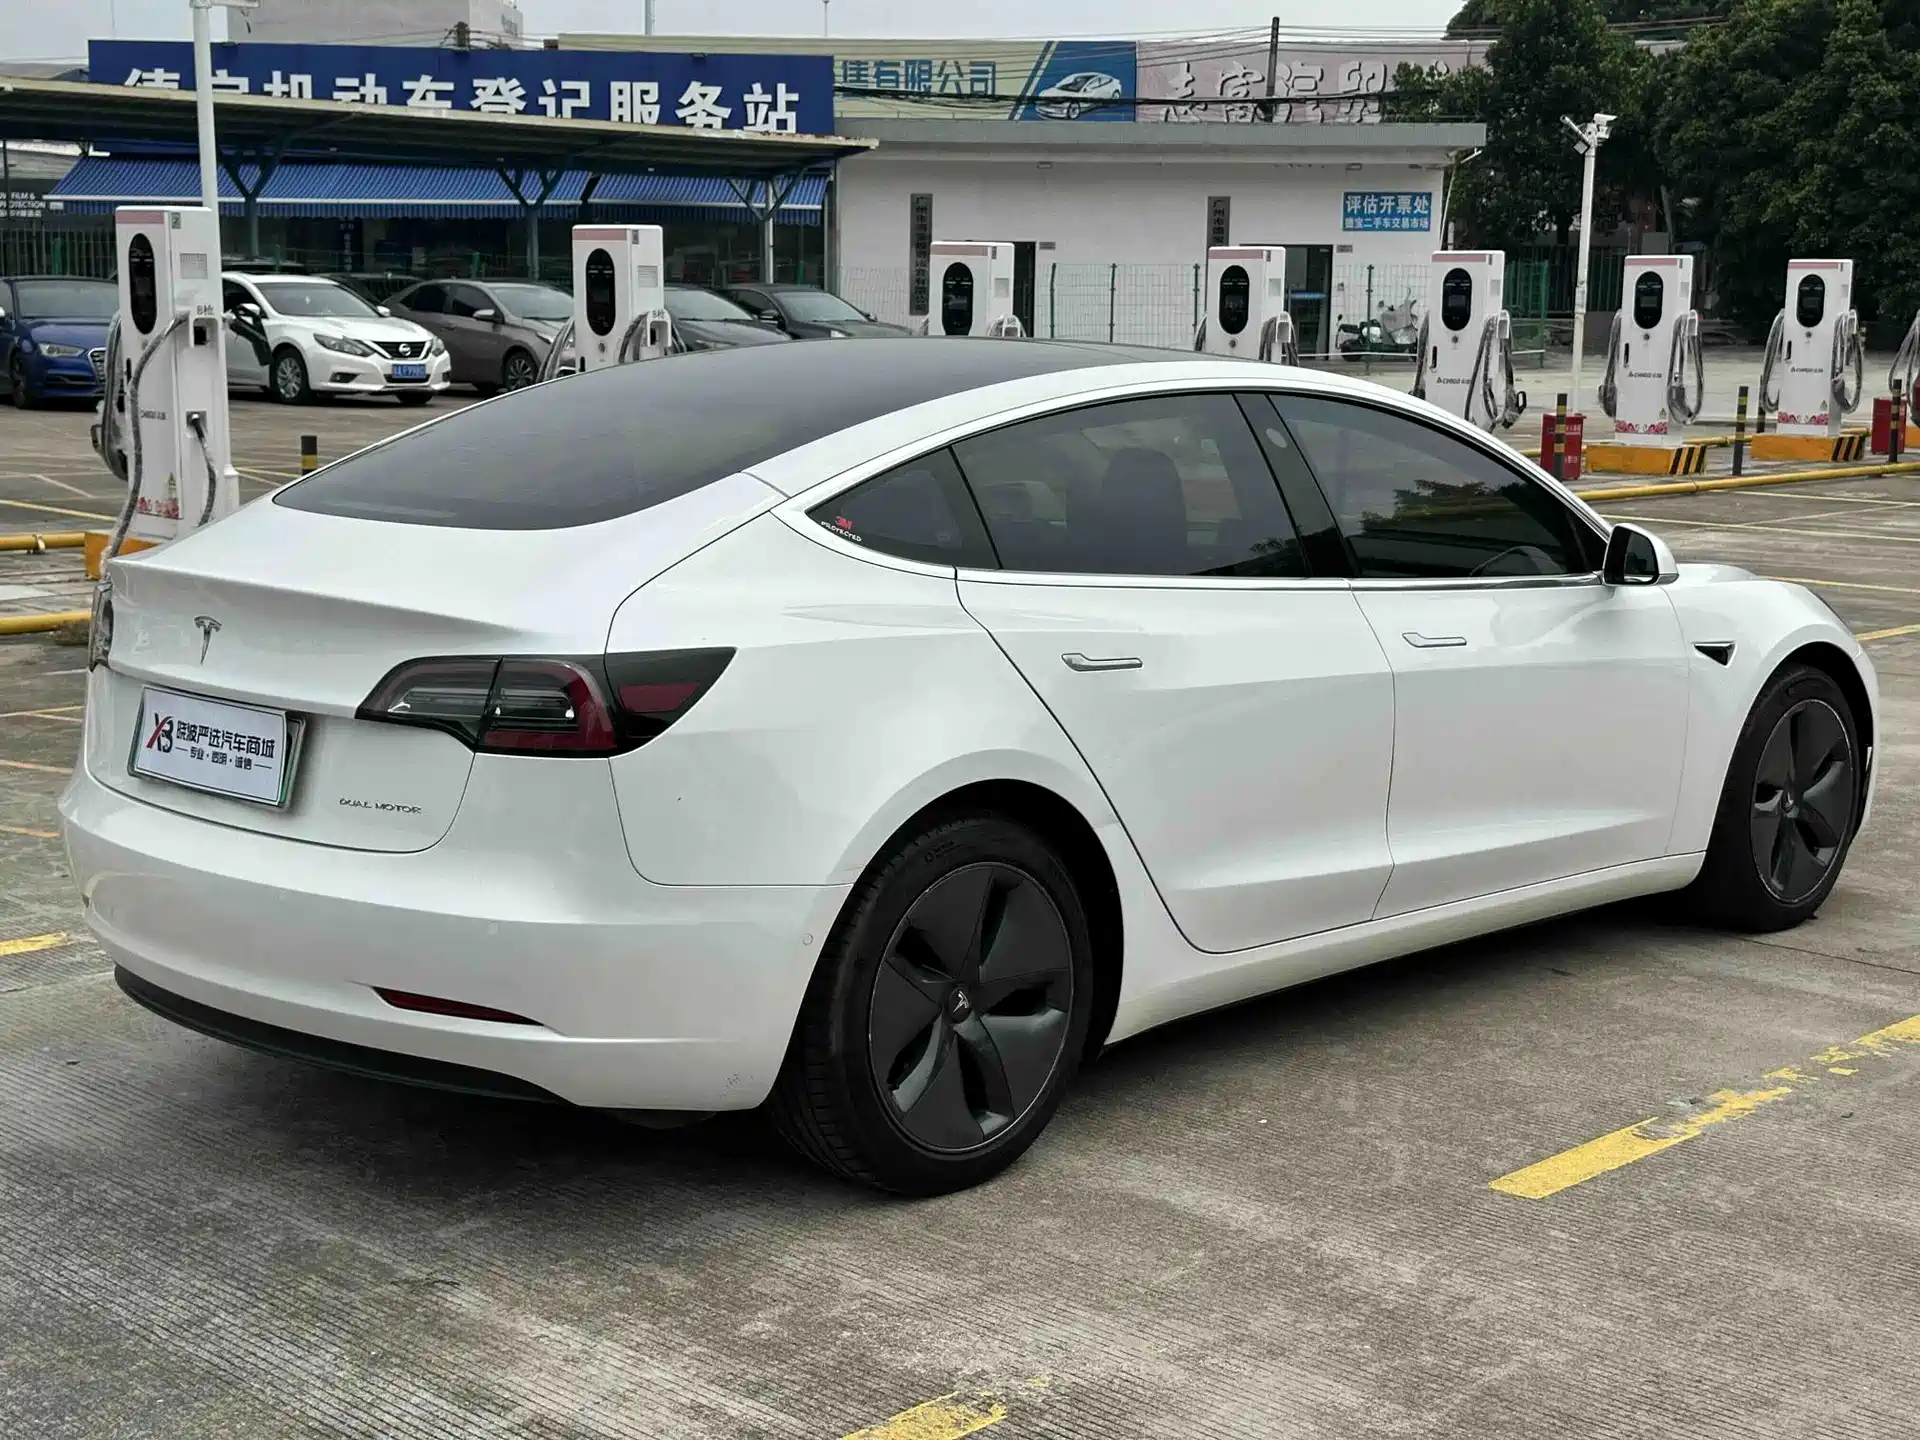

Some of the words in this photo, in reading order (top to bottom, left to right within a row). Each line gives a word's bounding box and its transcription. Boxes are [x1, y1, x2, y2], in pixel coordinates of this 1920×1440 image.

[1346, 195, 1429, 215] 评估开票处
[176, 720, 276, 759] 晓波严选汽车商城
[339, 798, 372, 809] DUAL
[375, 802, 422, 814] MOTOR
